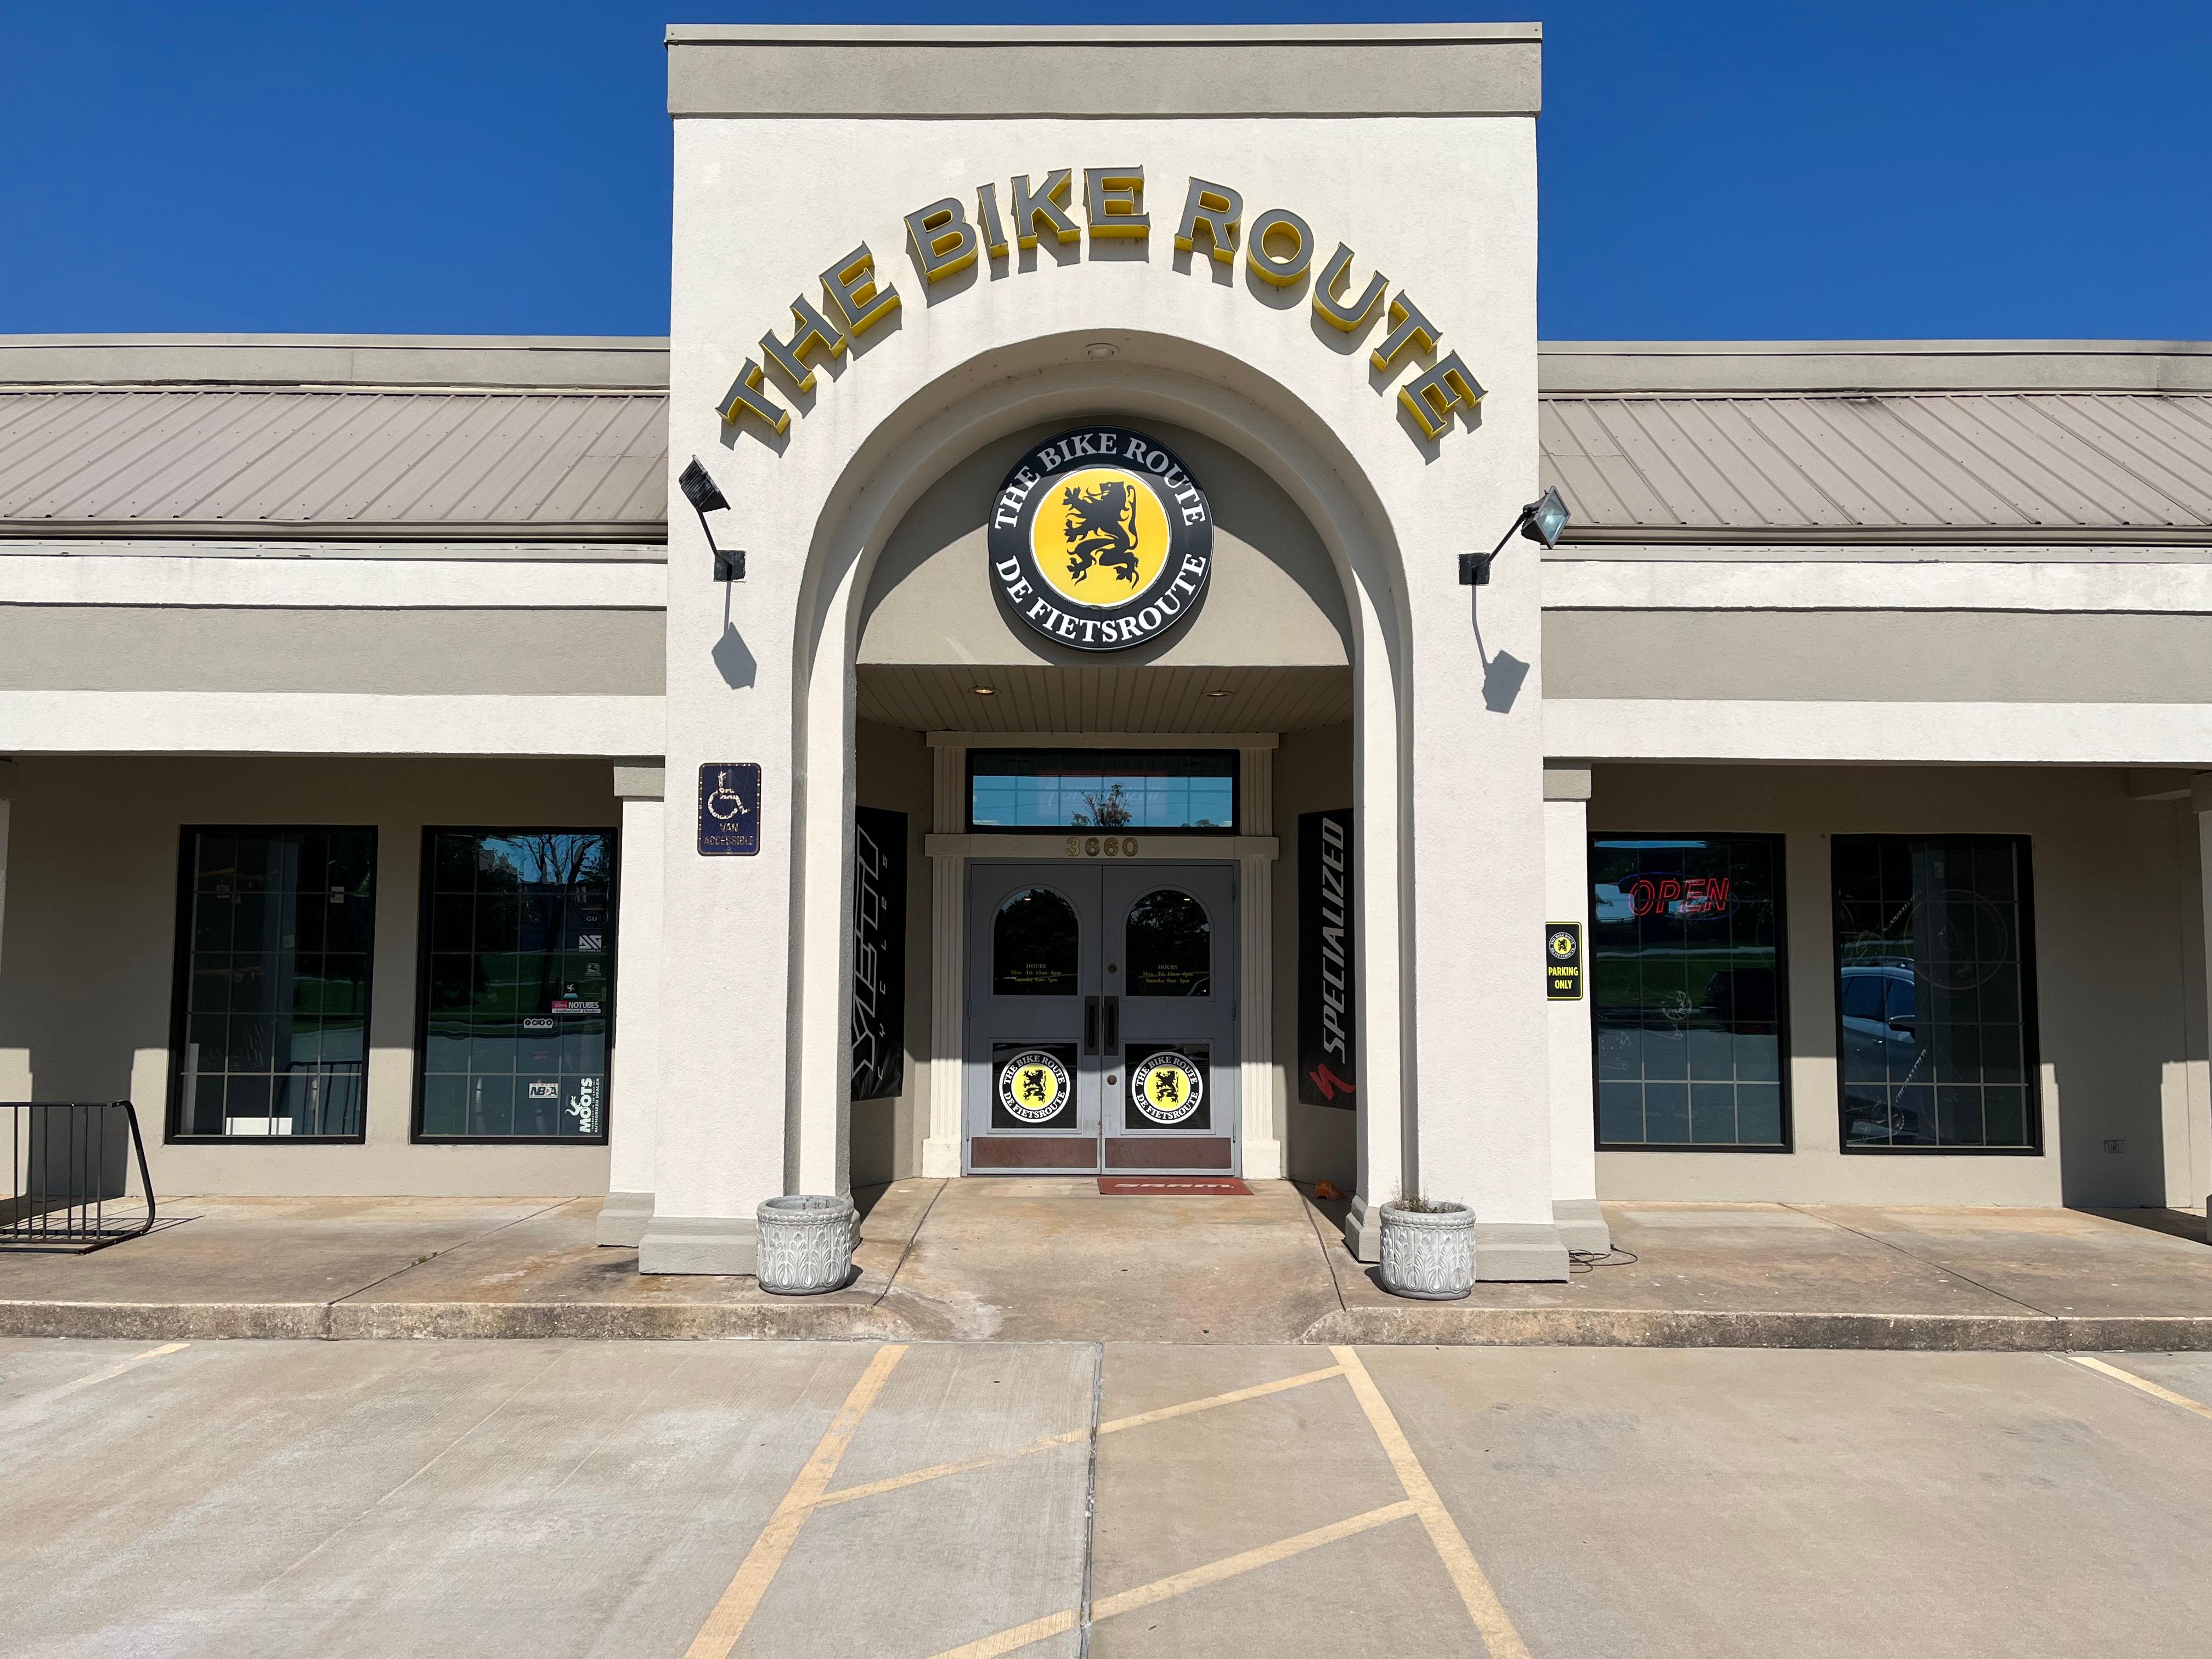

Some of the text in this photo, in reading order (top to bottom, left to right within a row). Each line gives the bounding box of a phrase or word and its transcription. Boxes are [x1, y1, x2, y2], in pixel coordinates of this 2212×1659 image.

[715, 165, 1488, 441] THE BIKE ROUTE
[995, 433, 1206, 529] THE BIKE ROUTE
[996, 553, 1206, 642] DE FIETSROUTE
[704, 836, 754, 845] ACCESSIBLE
[719, 823, 739, 832] VAN
[1066, 837, 1138, 856] 3660
[1628, 877, 1730, 917] OPEN
[1322, 817, 1345, 1064] SPECIALIZED
[1548, 967, 1578, 976] PARKING
[1555, 979, 1572, 989] ONLY
[1003, 1055, 1065, 1085] THE BIKE ROUTE
[1136, 1056, 1198, 1086] THE BIKE ROUTE
[579, 1077, 592, 1133] MOOTS
[1004, 1091, 1065, 1118] DE FIETSROUTE
[1137, 1092, 1198, 1119] DE FIETSROUTE
